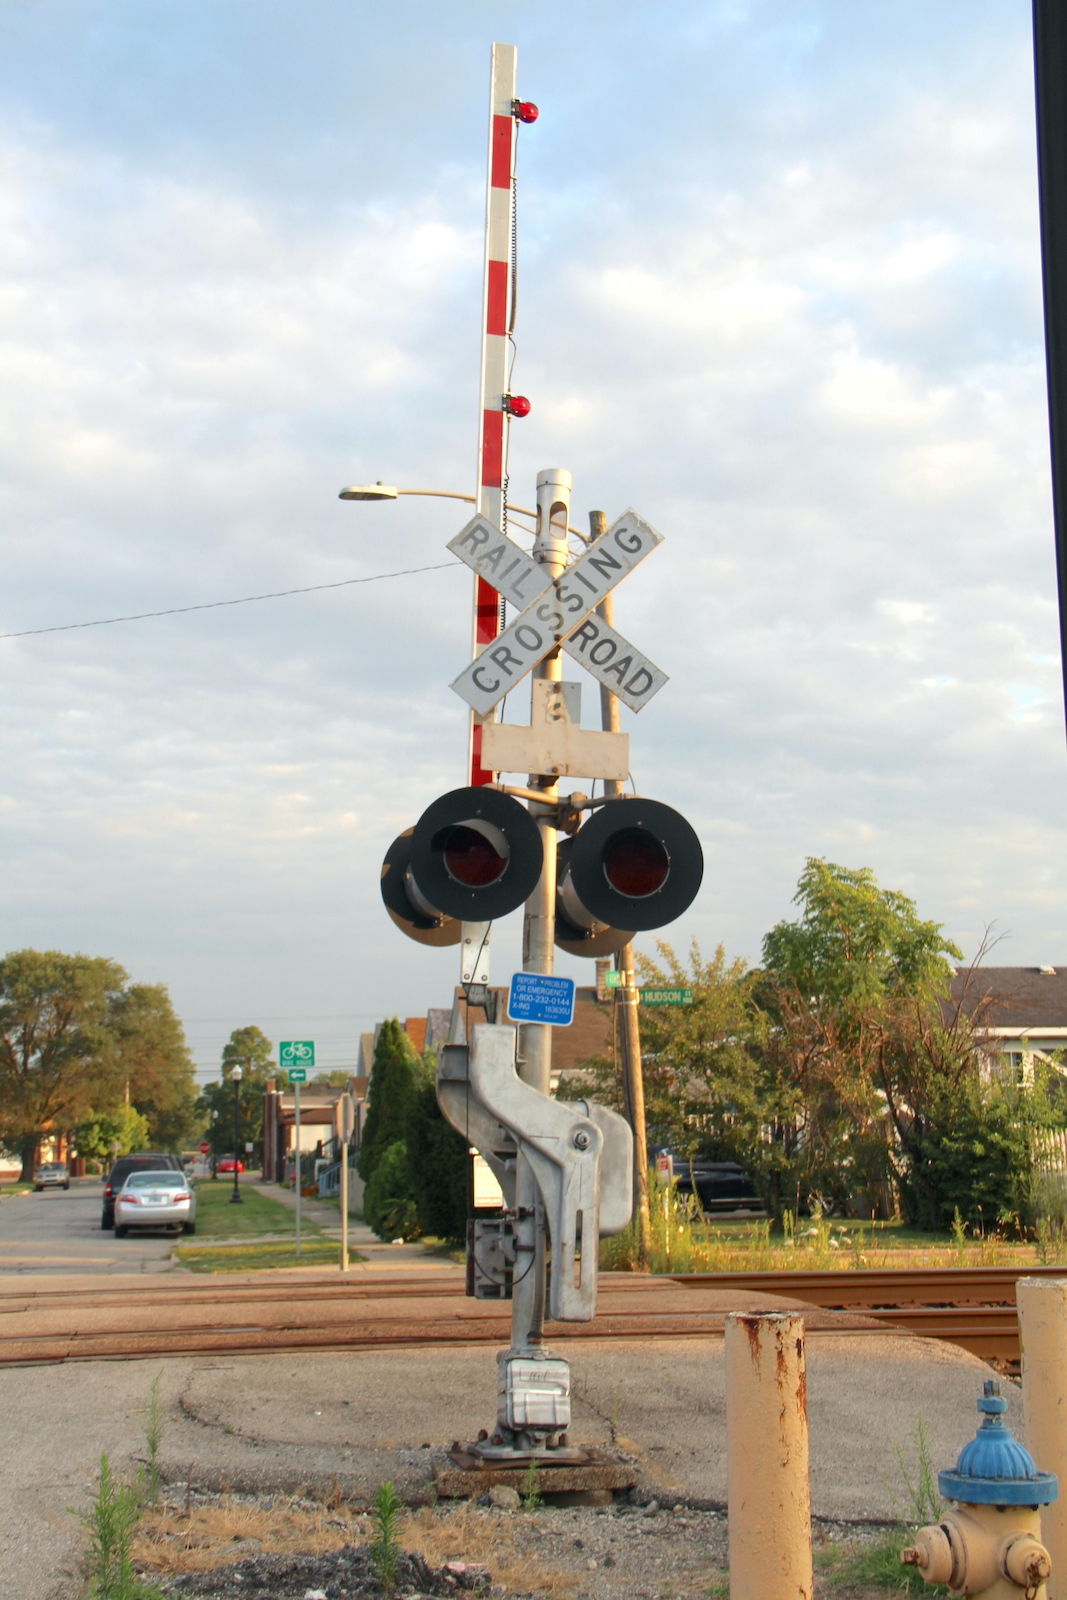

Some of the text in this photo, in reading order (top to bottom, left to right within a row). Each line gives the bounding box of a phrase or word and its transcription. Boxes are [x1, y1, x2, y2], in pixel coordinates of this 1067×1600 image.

[459, 523, 653, 697] RAIL ROAD
[471, 527, 643, 693] CROSSING
[517, 976, 568, 988] REPORT PROBLEM
[527, 986, 568, 996] EMERGENCY
[644, 991, 681, 1002] HUDSON
[513, 993, 570, 1006] 1-800-232-0144
[512, 1002, 530, 1010] X-ING
